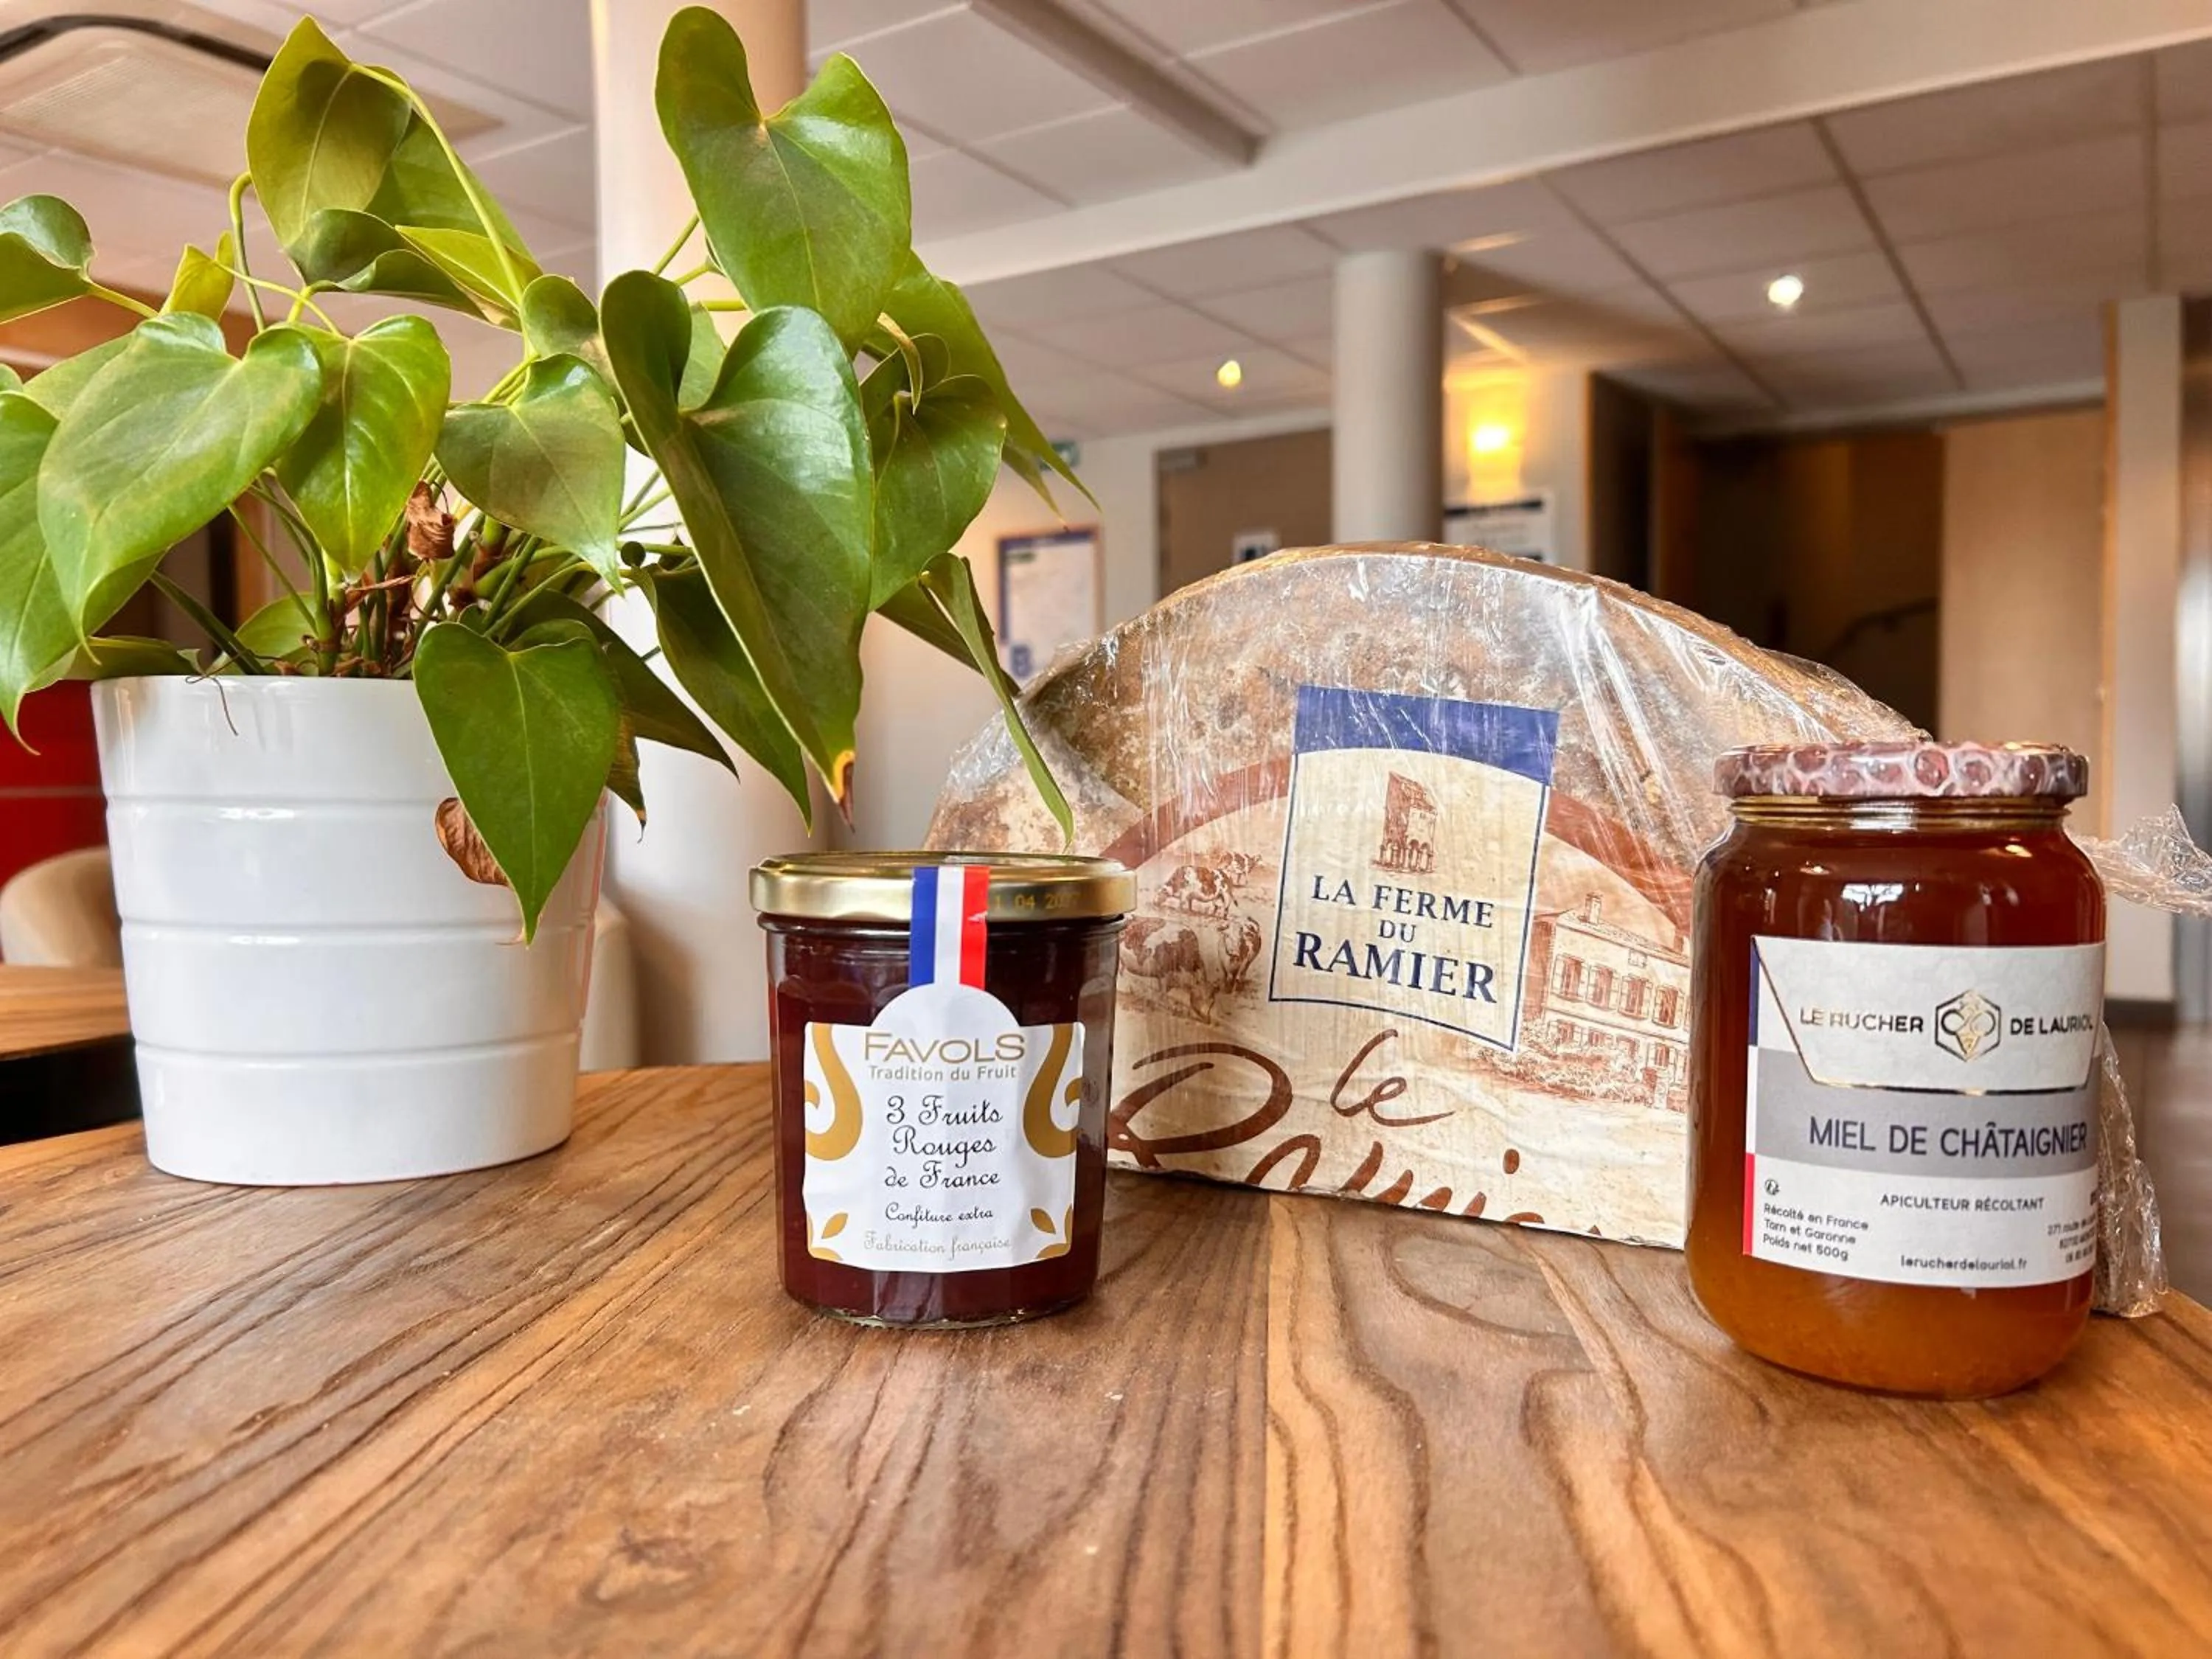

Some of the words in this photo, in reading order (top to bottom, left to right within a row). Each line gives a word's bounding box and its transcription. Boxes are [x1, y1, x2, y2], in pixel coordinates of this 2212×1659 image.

[1311, 875, 1356, 905] LA
[1372, 884, 1495, 928] FERME
[1377, 919, 1416, 943] DU
[1293, 931, 1497, 1004] RAMIER
[1800, 1007, 1824, 1027] LE
[1830, 1009, 1924, 1033] RUCHER
[2009, 1017, 2035, 1036] DE
[864, 1032, 1026, 1064] FAVOLS
[869, 1065, 944, 1081] Tradition
[950, 1068, 970, 1081] du
[977, 1064, 1017, 1079] Fruit
[1331, 1029, 1455, 1127] le
[886, 1095, 905, 1124] 3
[918, 1094, 1003, 1126] Fruits
[893, 1124, 996, 1169] Rouges
[1809, 1116, 1877, 1152] MIEL
[1889, 1125, 1927, 1155] DE
[1940, 1121, 2087, 1158] CHÂTAIGNIER
[884, 1166, 908, 1188] de
[919, 1160, 1001, 1189] France
[884, 1201, 953, 1229] Confiture
[958, 1206, 994, 1221] extra
[1763, 1203, 1804, 1221] Récolté
[1807, 1214, 1823, 1225] en
[1826, 1214, 1869, 1231] France
[1879, 1193, 1969, 1211] APICULTEUR
[1975, 1195, 2045, 1212] RÉCOLTANT
[863, 1230, 946, 1254] Fabrication
[948, 1234, 1013, 1262] française
[1764, 1218, 1787, 1233] Tarn
[1790, 1225, 1801, 1237] et
[1804, 1227, 1857, 1245] Garonne
[1762, 1233, 1790, 1249] Poids
[1793, 1240, 1812, 1254] net
[1816, 1243, 1849, 1262] 500g
[1900, 1254, 2028, 1271] lerucherdelauriol.fr
